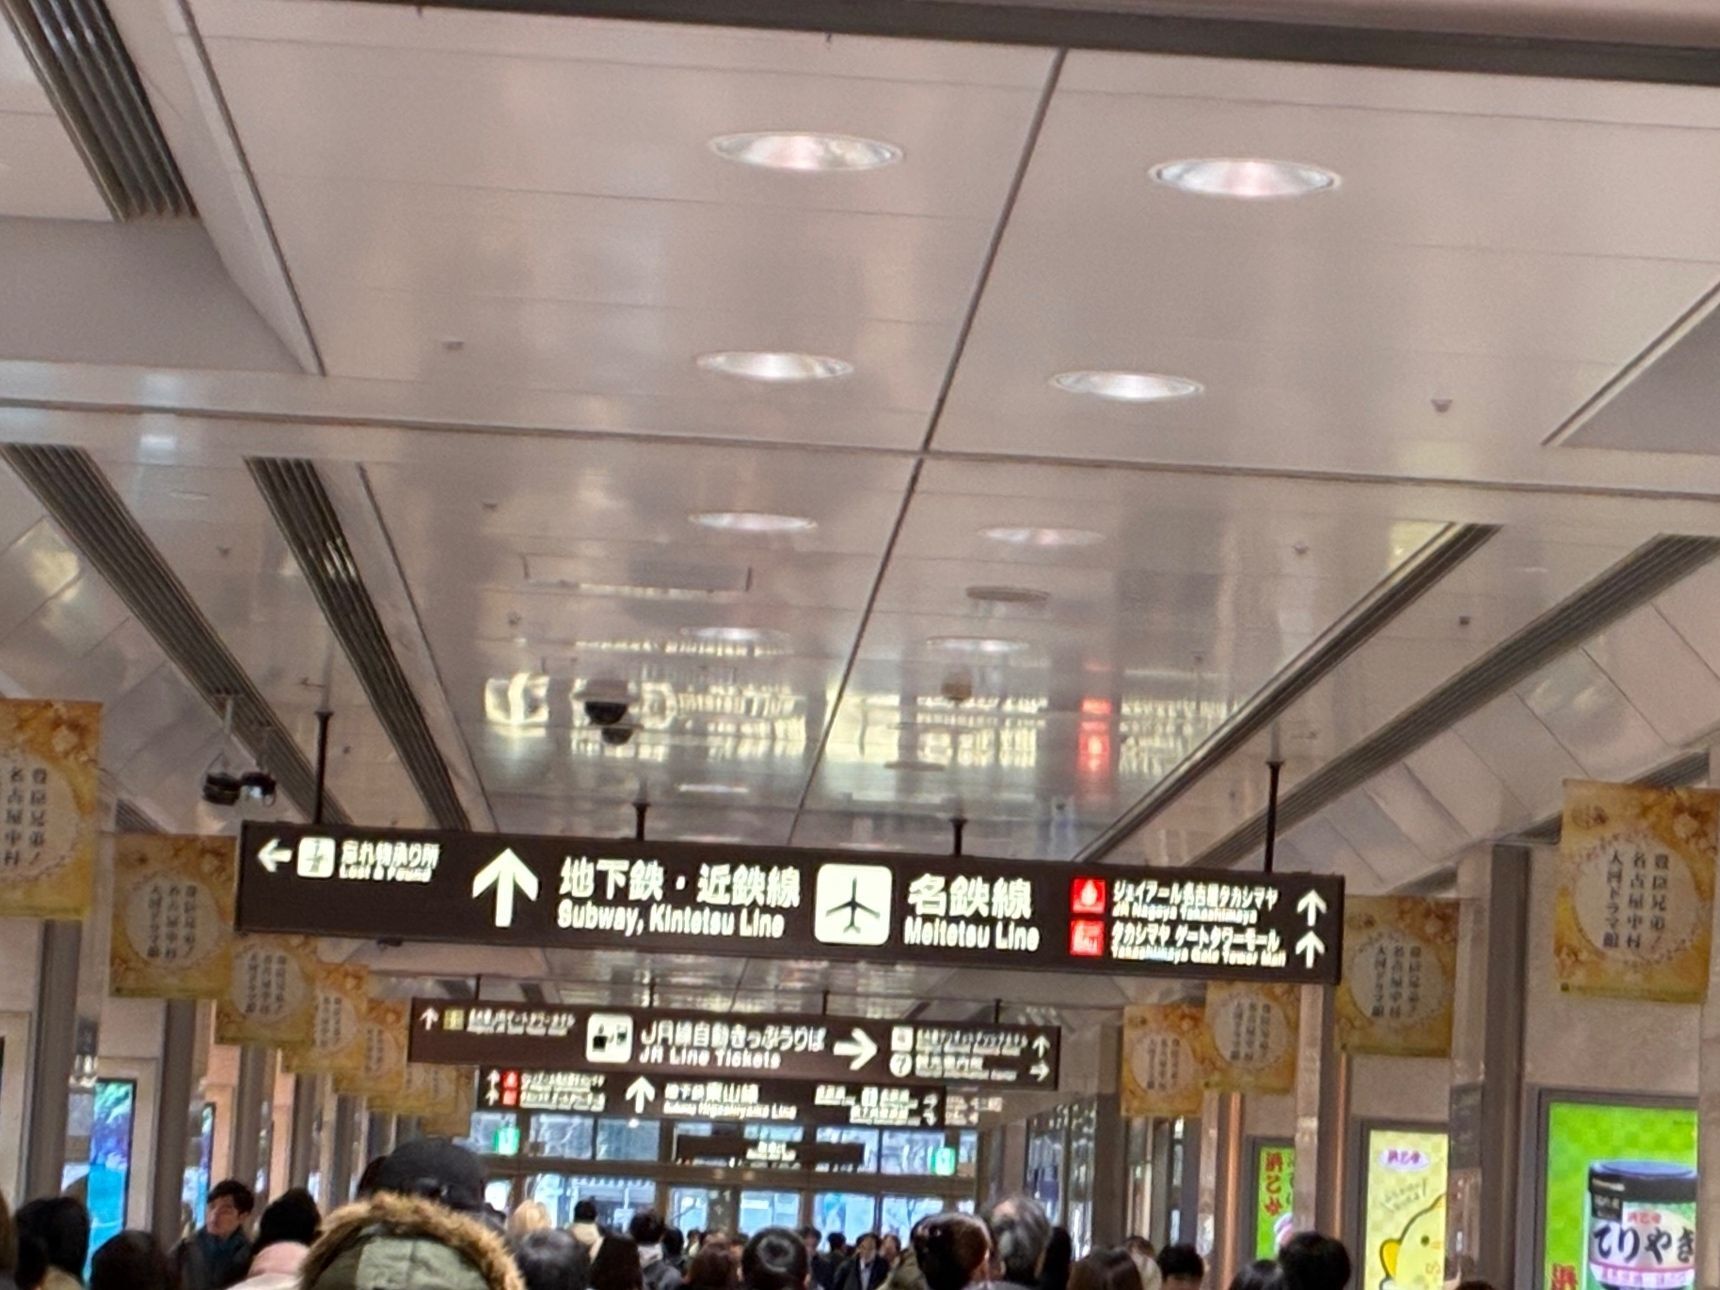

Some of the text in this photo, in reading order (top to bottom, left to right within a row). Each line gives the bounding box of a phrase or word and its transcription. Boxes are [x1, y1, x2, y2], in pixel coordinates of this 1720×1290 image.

[558, 856, 801, 907] 地下鉄・近鉄線
[907, 873, 1033, 919] 名鉄線
[557, 899, 785, 938] Subway, Kintetsu Line
[903, 915, 1041, 952] Meitetsu Line
[640, 1019, 828, 1052] JR線自動きっぷうりば
[638, 1045, 781, 1069] JR Line Tickets
[1592, 1224, 1695, 1264] てりやき
